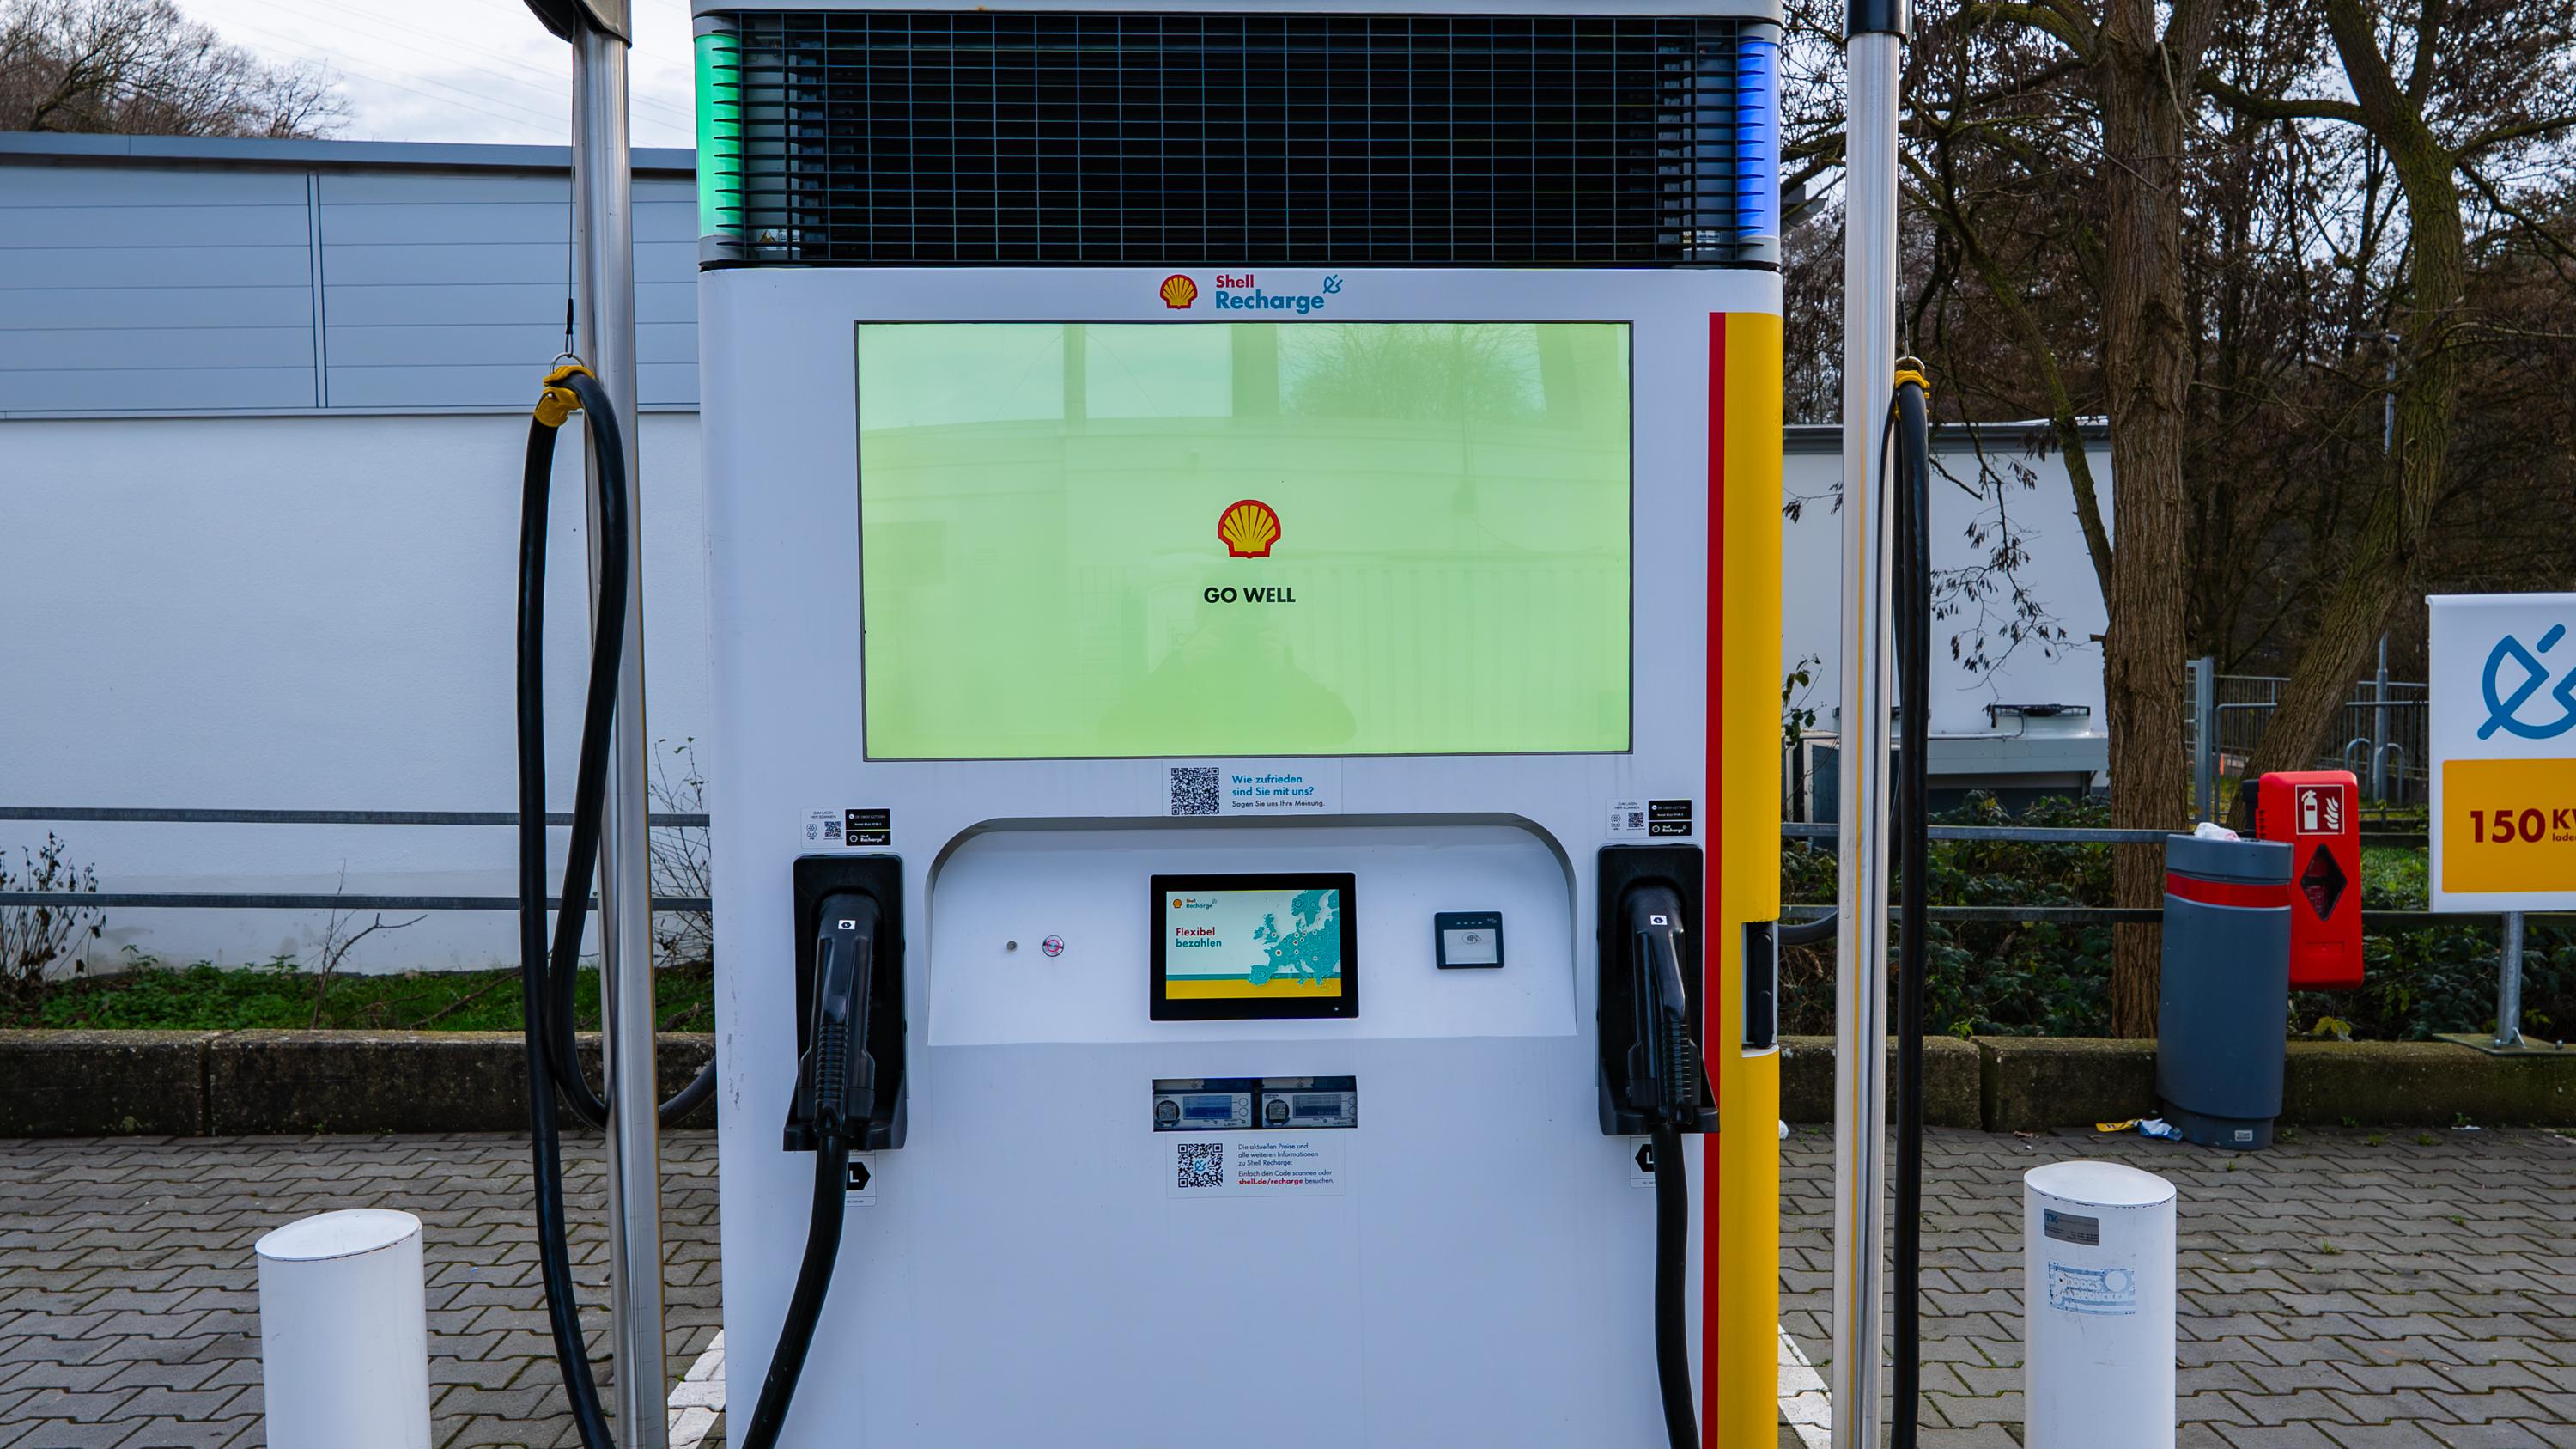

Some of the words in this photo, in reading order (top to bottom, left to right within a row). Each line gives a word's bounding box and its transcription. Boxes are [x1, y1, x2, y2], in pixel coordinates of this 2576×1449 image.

[1216, 274, 1254, 288] Shell
[1215, 289, 1325, 314] Recharge
[1204, 587, 1238, 603] GO
[1242, 587, 1296, 603] WELL
[1232, 775, 1252, 784] Wie
[1255, 774, 1303, 783] zufrieden
[1232, 787, 1253, 796] sind
[1255, 787, 1271, 796] Sie
[1273, 787, 1290, 795] mit
[1292, 786, 1314, 795] uns?
[1295, 800, 1325, 808] Meinung.
[2470, 808, 2546, 844] 150
[2552, 808, 2576, 829] K
[2552, 832, 2576, 842] lade
[1176, 927, 1216, 936] Flexibel
[1176, 938, 1222, 947] bezahlen
[1646, 1152, 1655, 1164] L
[849, 1169, 860, 1183] L
